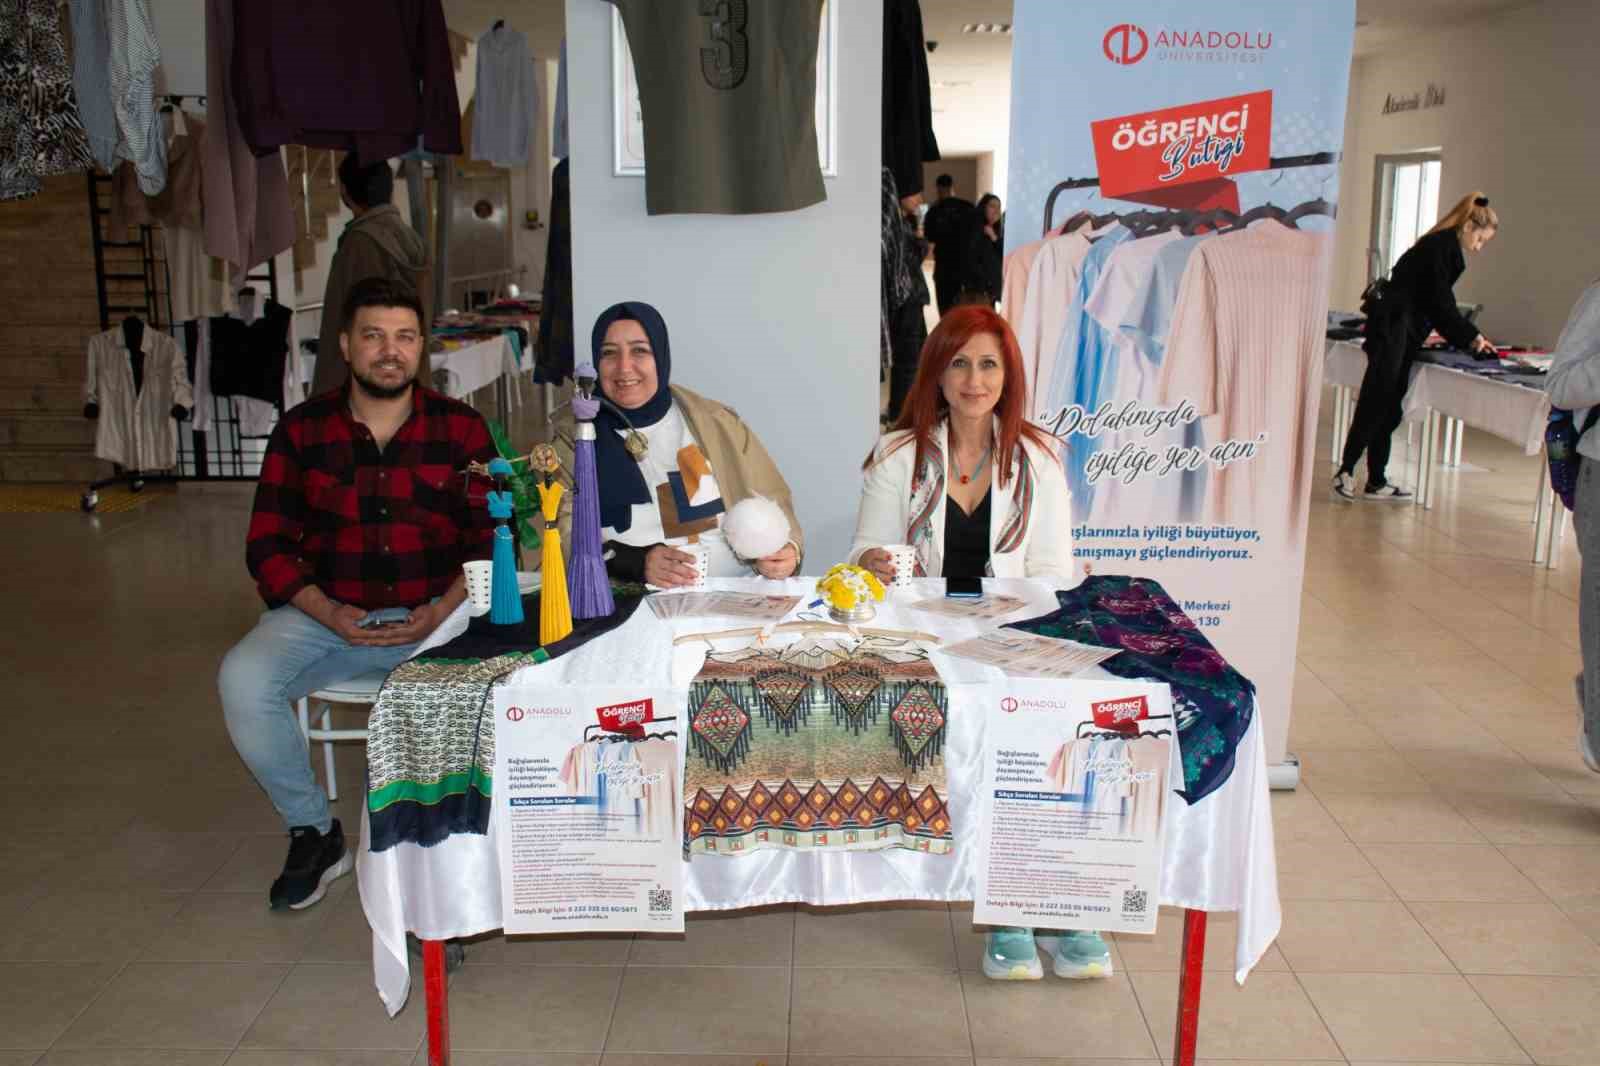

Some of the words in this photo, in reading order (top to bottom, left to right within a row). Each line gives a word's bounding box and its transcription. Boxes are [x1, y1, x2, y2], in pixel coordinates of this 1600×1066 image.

[1154, 30, 1273, 49] ANADOLU
[1112, 104, 1249, 151] ÖĞRENCİ
[1086, 443, 1158, 484] iyiliğe
[1159, 446, 1200, 476] yer
[1143, 525, 1182, 541] iyiliği
[1186, 526, 1261, 542] büyütüyor,
[1073, 547, 1136, 561] anışmayı
[1139, 546, 1253, 561] güçlendiriyoruz.
[1184, 600, 1231, 610] Merkezi
